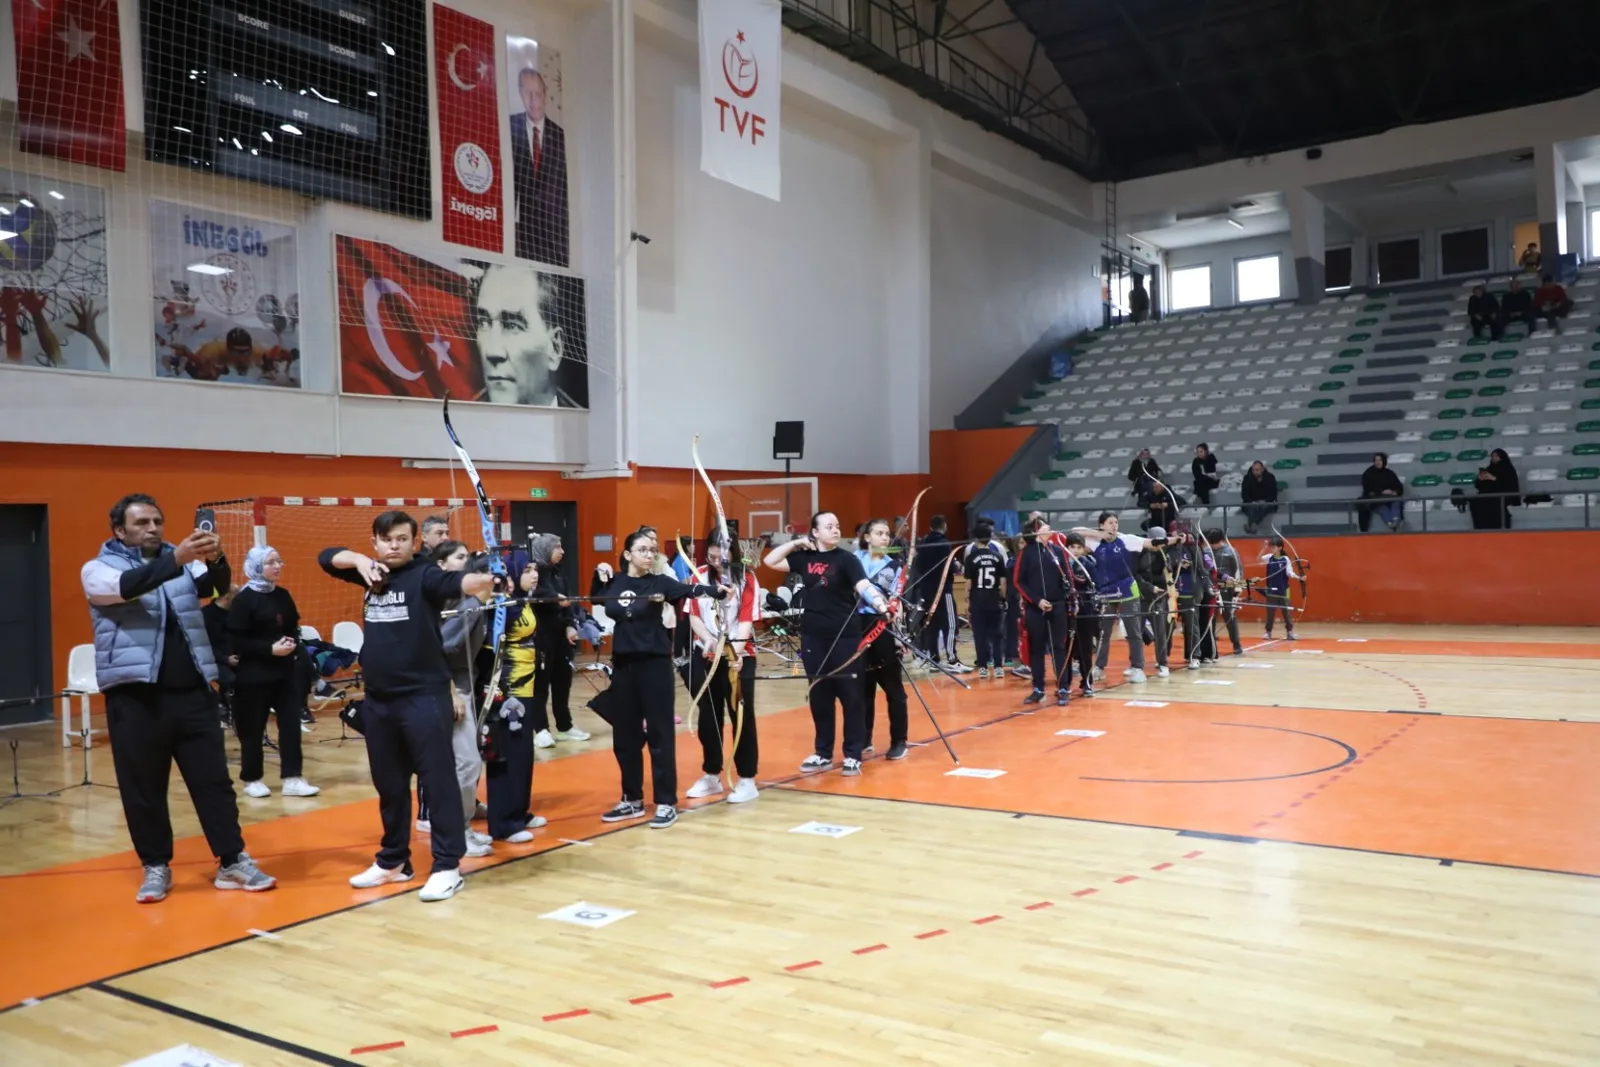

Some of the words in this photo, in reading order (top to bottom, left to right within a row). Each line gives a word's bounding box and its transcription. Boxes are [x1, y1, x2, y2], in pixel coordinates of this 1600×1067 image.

[238, 13, 269, 31] SCORE
[339, 9, 367, 26] GUEST
[328, 43, 356, 59] SCORE
[234, 92, 256, 106] FOUL
[714, 96, 766, 146] TVF
[977, 567, 996, 589] 15
